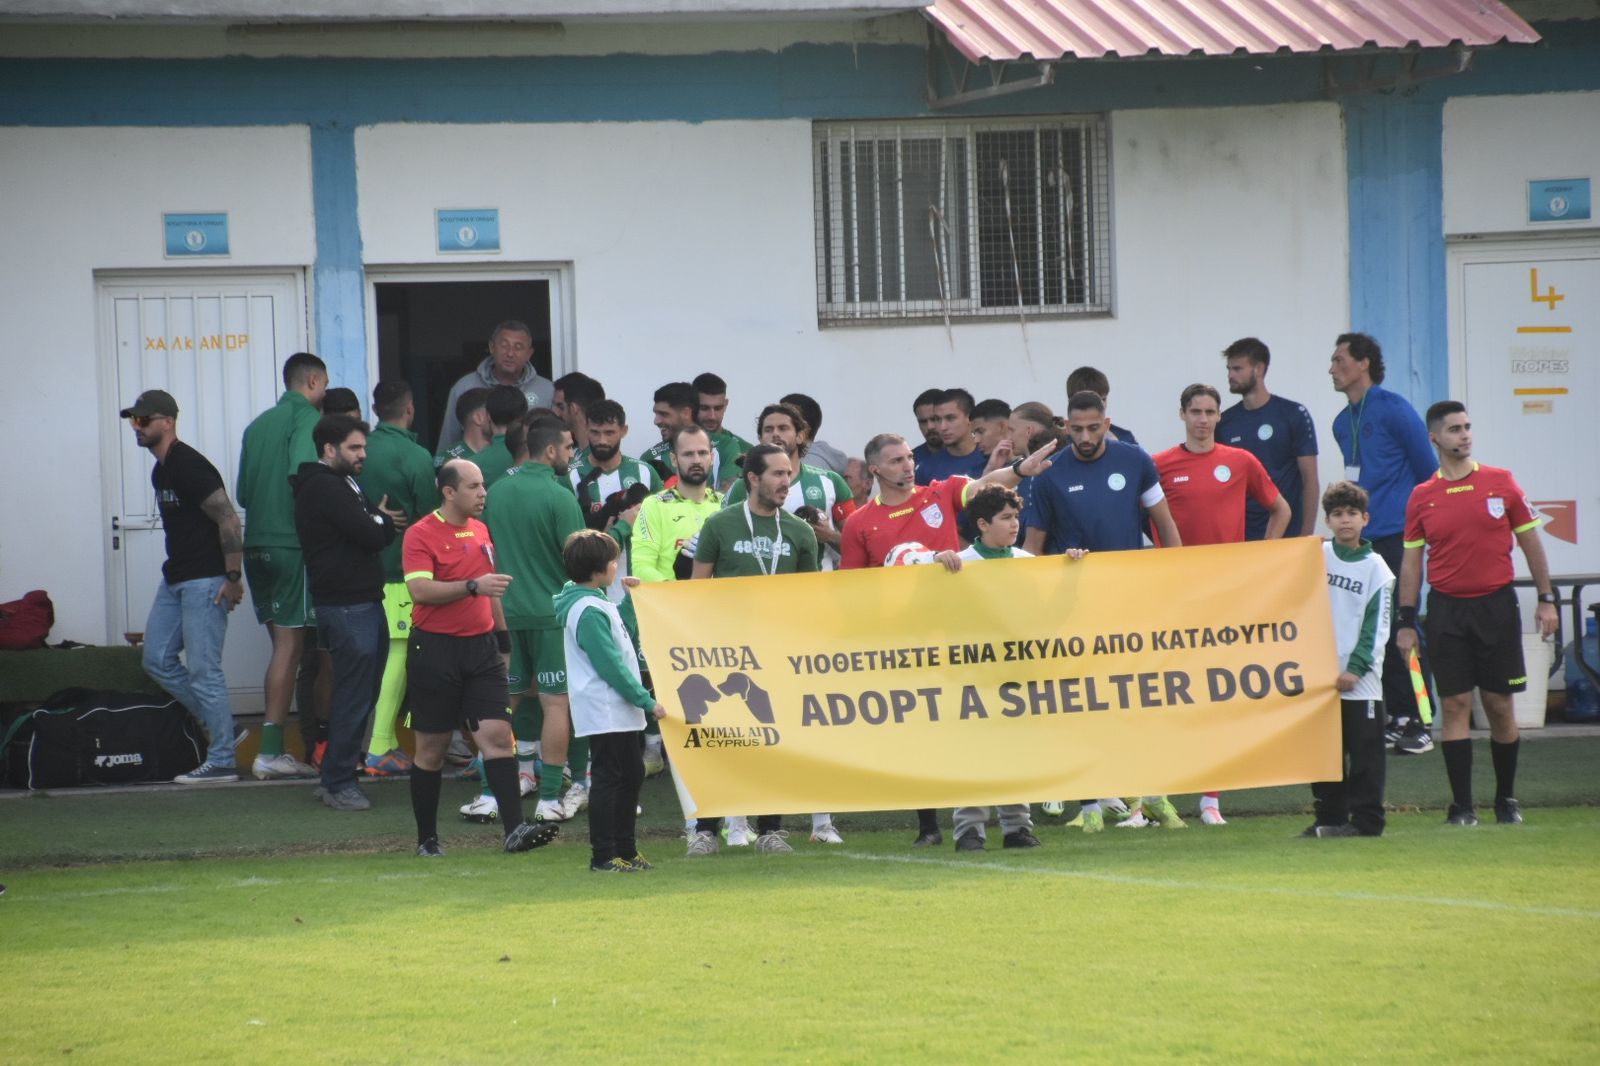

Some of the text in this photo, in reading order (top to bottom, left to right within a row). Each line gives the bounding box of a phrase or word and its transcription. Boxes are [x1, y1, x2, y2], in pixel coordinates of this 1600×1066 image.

[1530, 267, 1565, 311] 4
[1511, 359, 1569, 374] ROPES
[1326, 572, 1364, 595] oma
[669, 645, 763, 672] SIMBA
[787, 621, 1298, 675] ΥΙΟΘΕΤΗΣΤΕ ΕΝΑ ΣΚΥΛΟ ΑΠΟ ΚΑΤΑΦΥΓΙΟ
[537, 670, 566, 684] one
[801, 660, 1305, 727] ADOPT A SHELTER DOG
[683, 726, 781, 748] ANIMAL AID
[706, 738, 761, 748] CYPRUS
